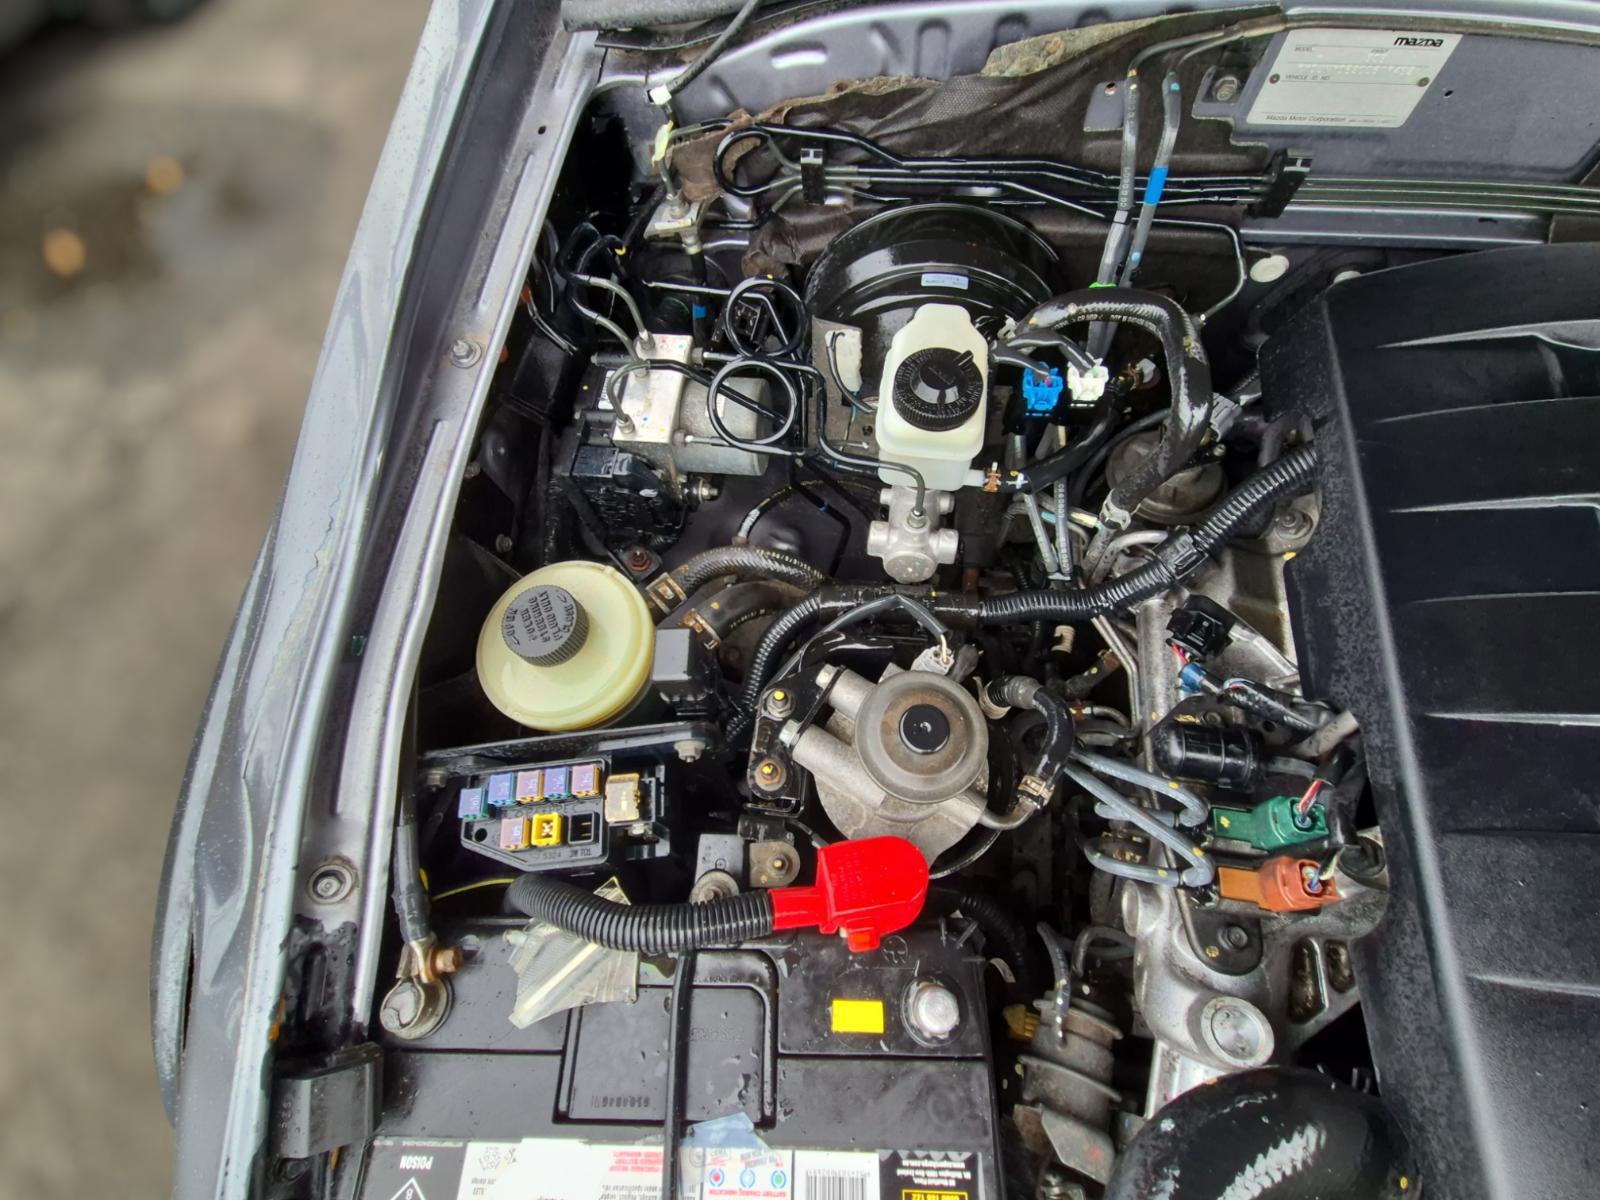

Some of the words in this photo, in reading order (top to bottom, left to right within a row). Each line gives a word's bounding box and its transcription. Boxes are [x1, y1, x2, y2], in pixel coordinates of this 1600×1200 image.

[540, 591, 553, 613] ONLY
[520, 608, 537, 642] POWER
[528, 596, 551, 643] STEERING
[546, 613, 563, 641] FLUID
[399, 1155, 433, 1171] POISON
[405, 1188, 413, 1200] 8
